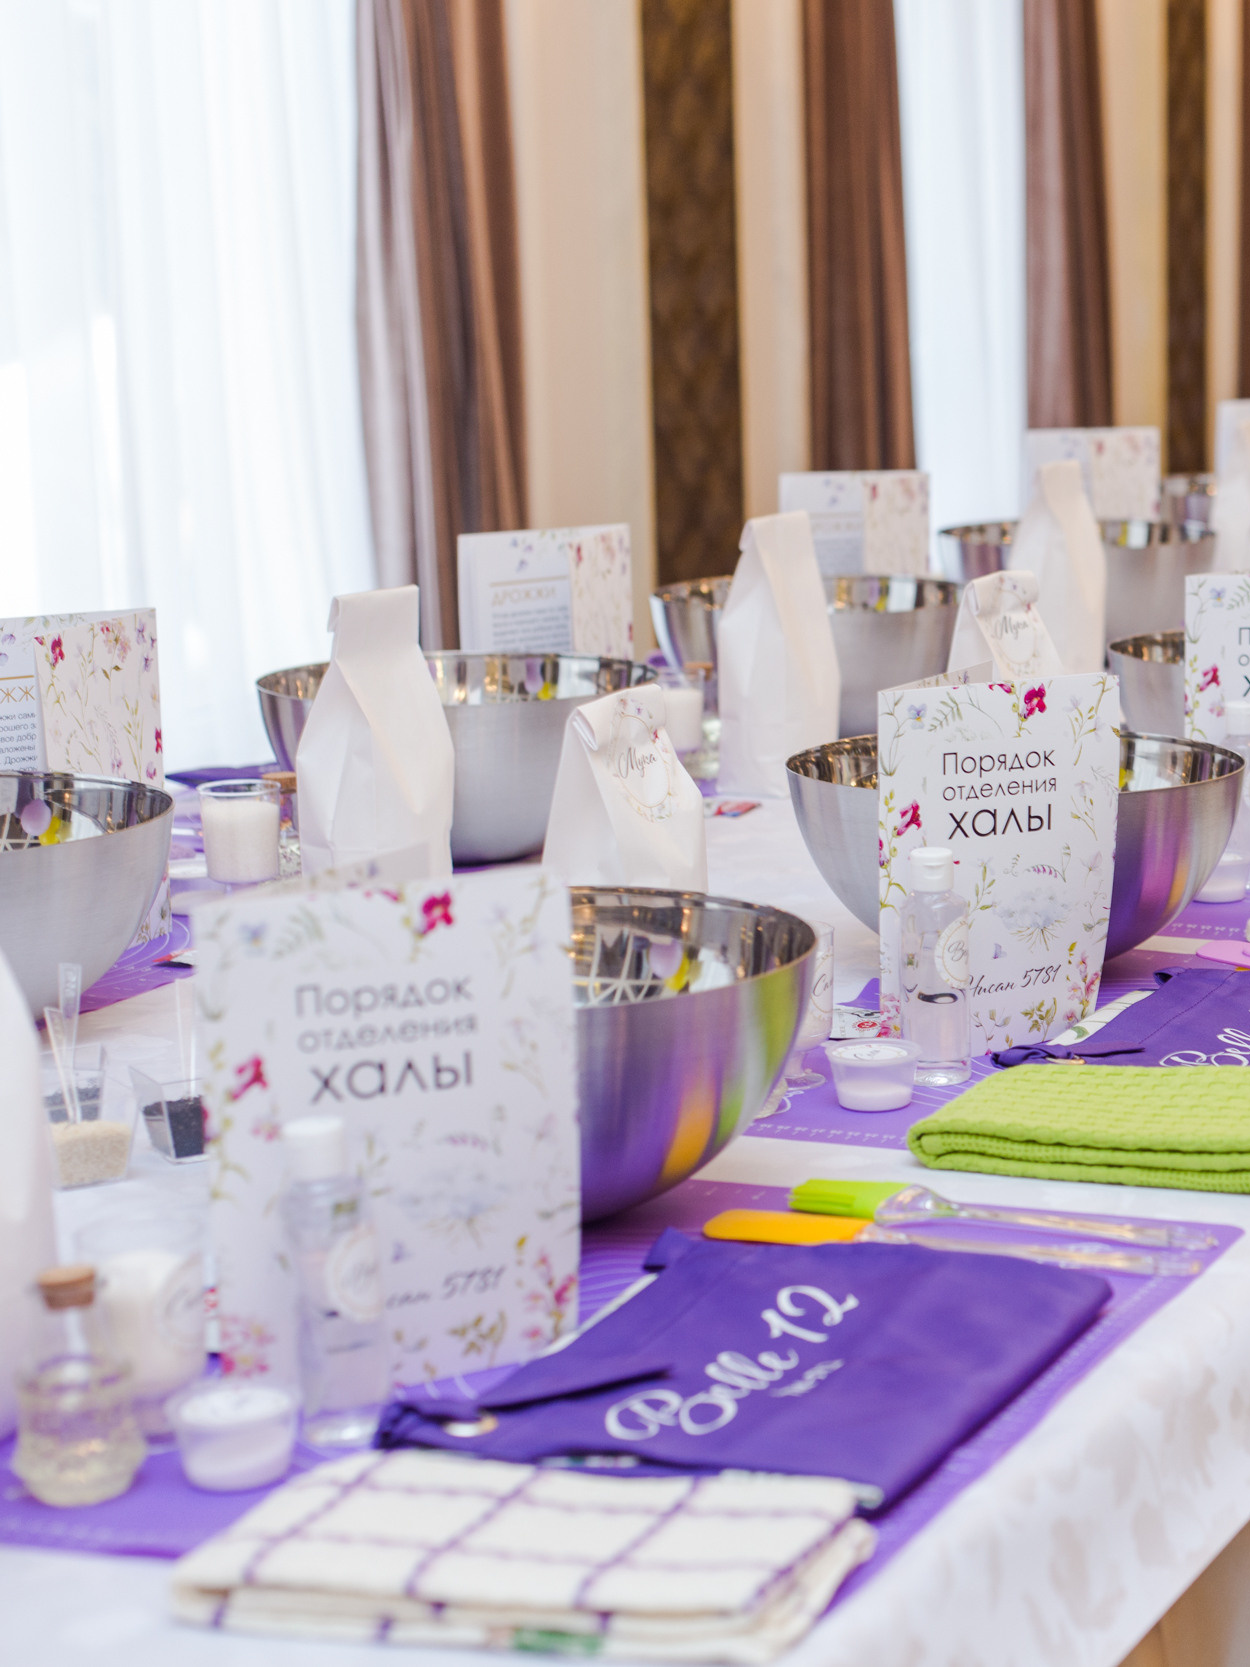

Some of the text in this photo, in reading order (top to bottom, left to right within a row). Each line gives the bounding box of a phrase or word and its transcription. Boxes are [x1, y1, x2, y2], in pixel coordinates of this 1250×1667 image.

[618, 746, 657, 779] Мука
[942, 749, 1056, 779] Порядок
[942, 777, 1057, 802] отделения
[948, 803, 1052, 840] халы
[1020, 963, 1063, 989] 5781
[294, 976, 474, 1021] Порядок
[297, 1012, 480, 1055] отделения
[309, 1050, 474, 1106] халы
[760, 1284, 860, 1344] 12
